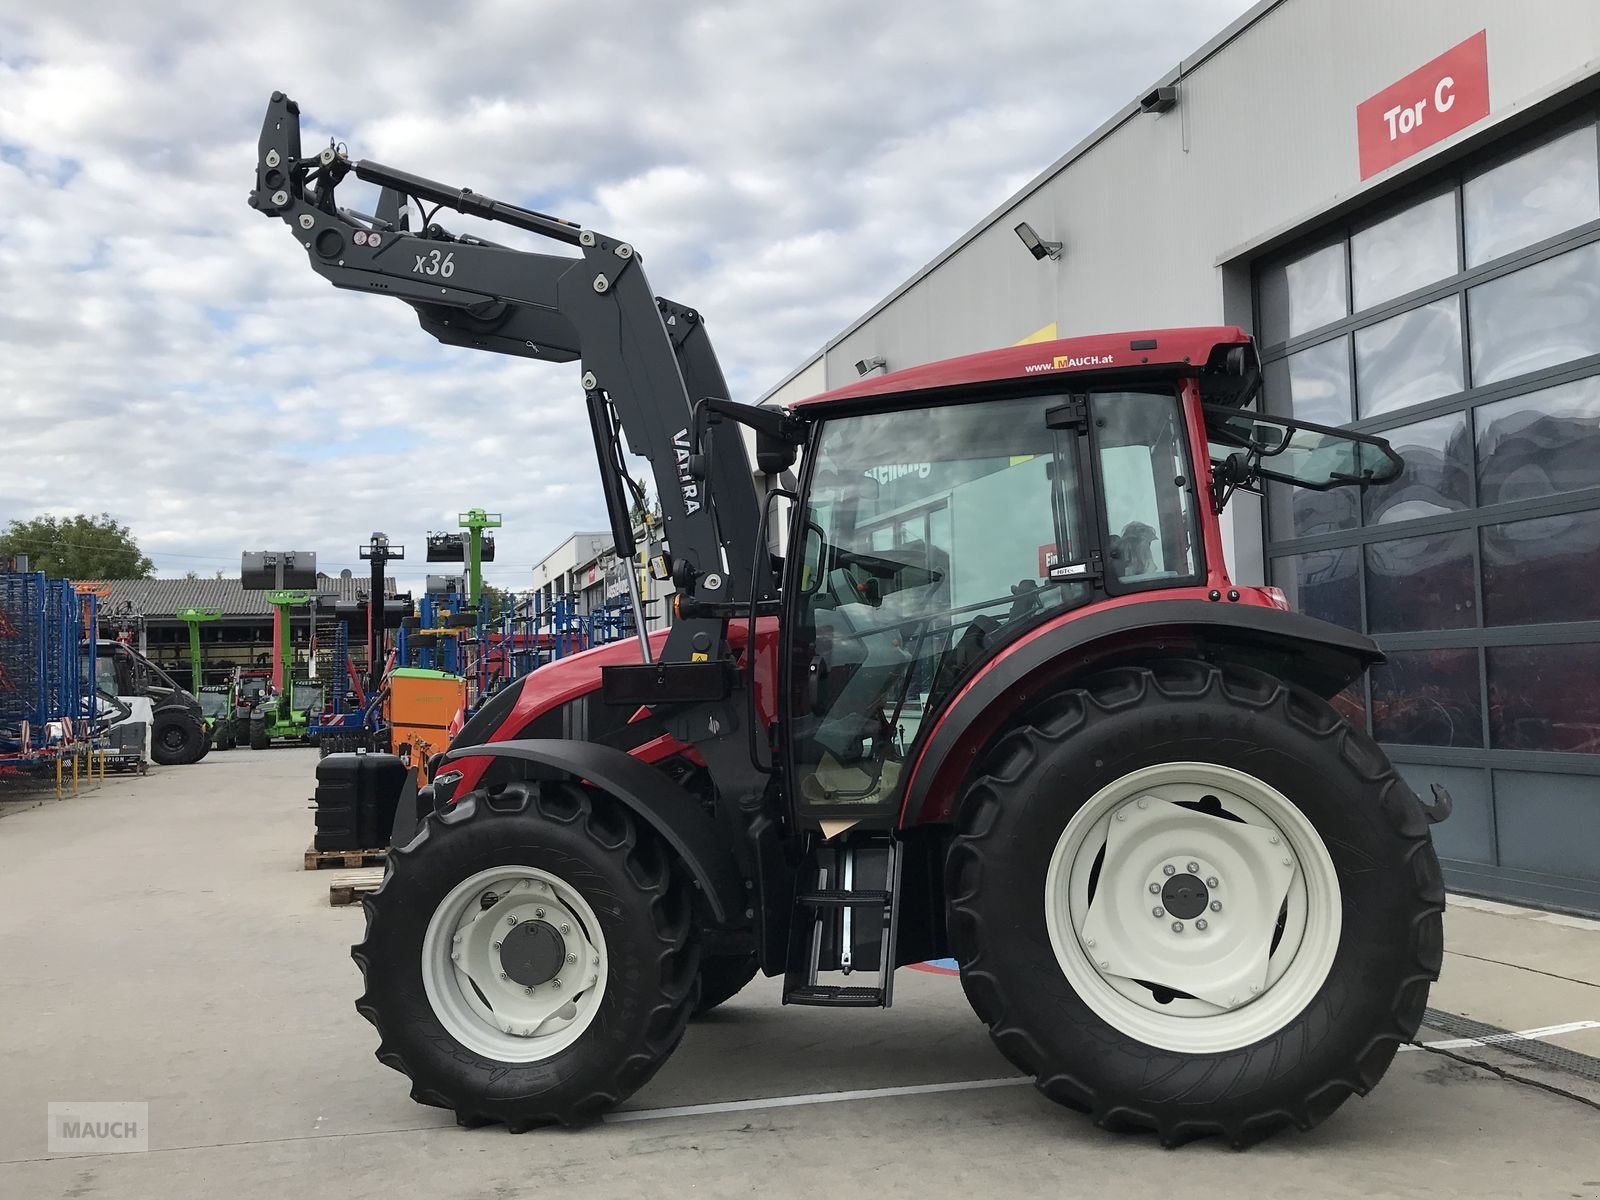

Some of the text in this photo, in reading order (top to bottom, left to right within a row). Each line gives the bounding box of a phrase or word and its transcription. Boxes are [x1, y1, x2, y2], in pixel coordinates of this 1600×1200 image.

[1384, 76, 1455, 141] Tor C
[412, 249, 455, 278] x36
[1025, 354, 1114, 373] www.MAUCH.at
